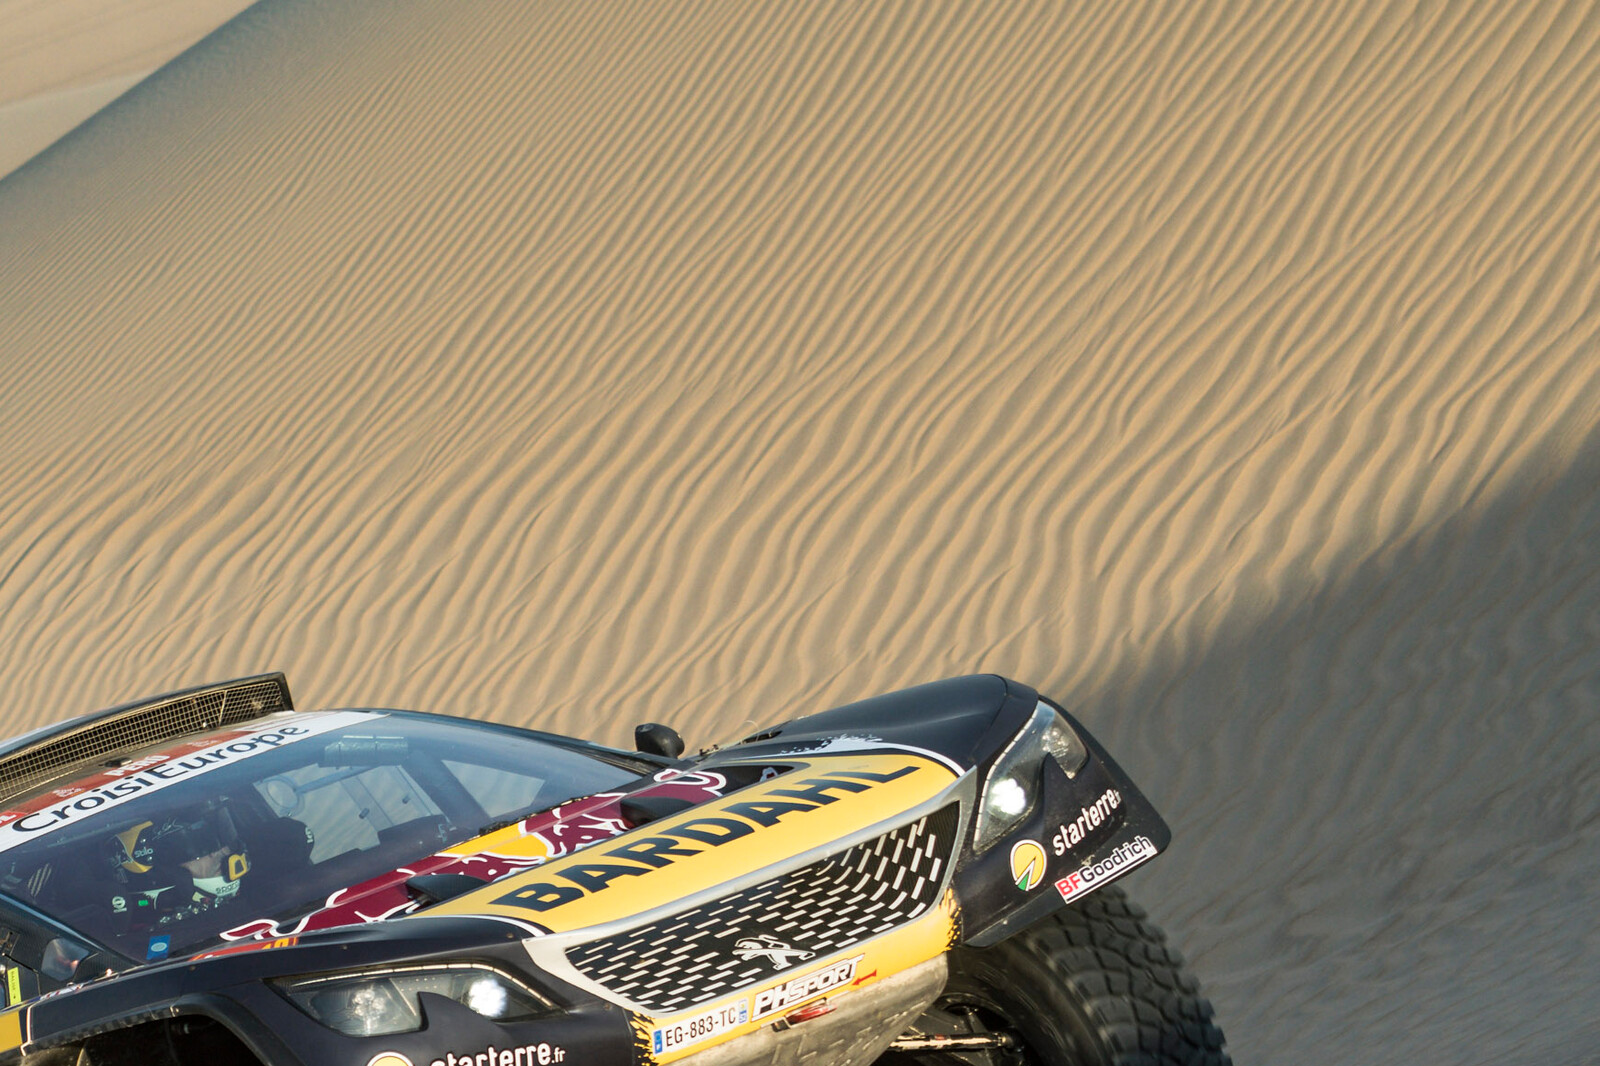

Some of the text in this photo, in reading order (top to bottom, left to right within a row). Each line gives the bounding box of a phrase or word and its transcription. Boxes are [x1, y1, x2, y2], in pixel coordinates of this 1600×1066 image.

[12, 726, 310, 832] CroisiEurope
[489, 766, 920, 912] BARDAHL
[1057, 836, 1151, 897] BFGoodrich
[665, 1007, 736, 1047] EG-883-TC
